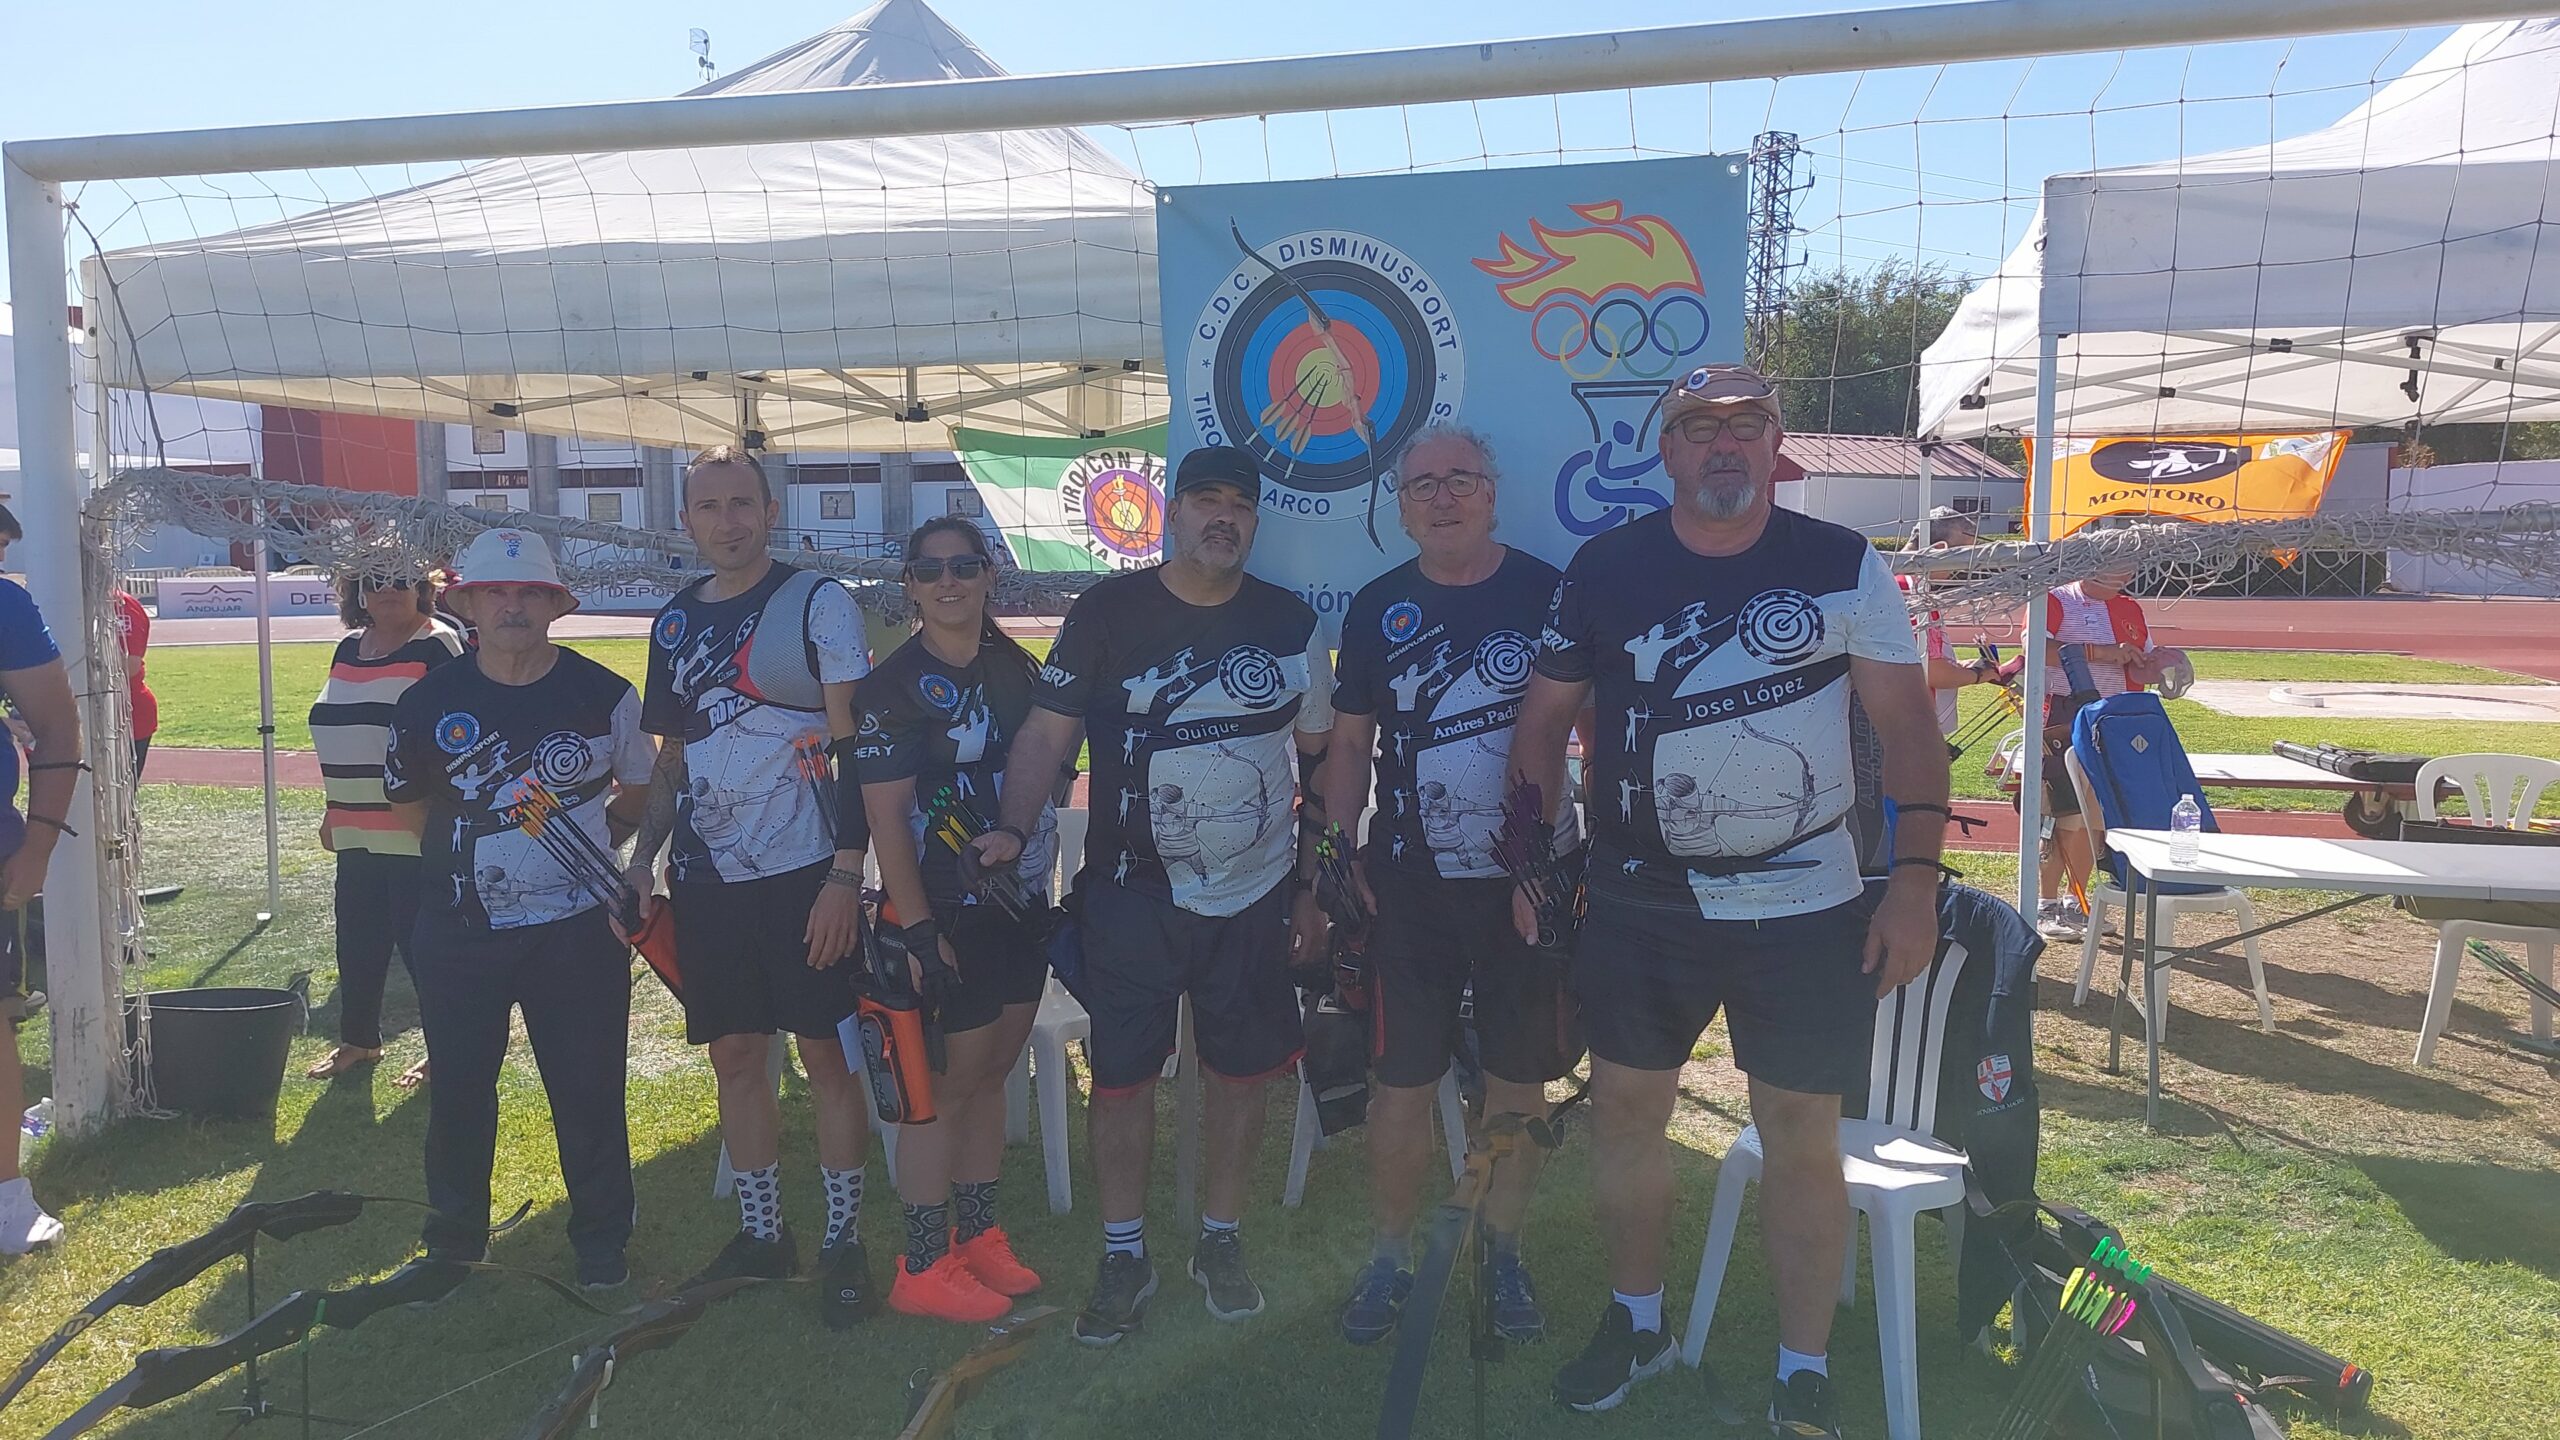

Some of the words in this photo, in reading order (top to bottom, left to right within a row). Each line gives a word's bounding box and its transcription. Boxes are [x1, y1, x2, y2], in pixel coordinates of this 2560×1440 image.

[1278, 237, 1457, 351] DISMINUSPORT
[1193, 392, 1223, 448] TIRO
[1262, 488, 1331, 516] ARCO
[1062, 470, 1086, 513] TIRO
[1086, 451, 1131, 474] CON
[2087, 488, 2226, 510] MONTORO
[290, 592, 337, 605] DEP
[608, 586, 677, 598] DEPO
[1292, 583, 1354, 613] ión
[1685, 698, 1736, 721] Jose
[1742, 676, 1806, 705] López
[1175, 721, 1240, 742] Quique
[1432, 716, 1485, 741] Andres
